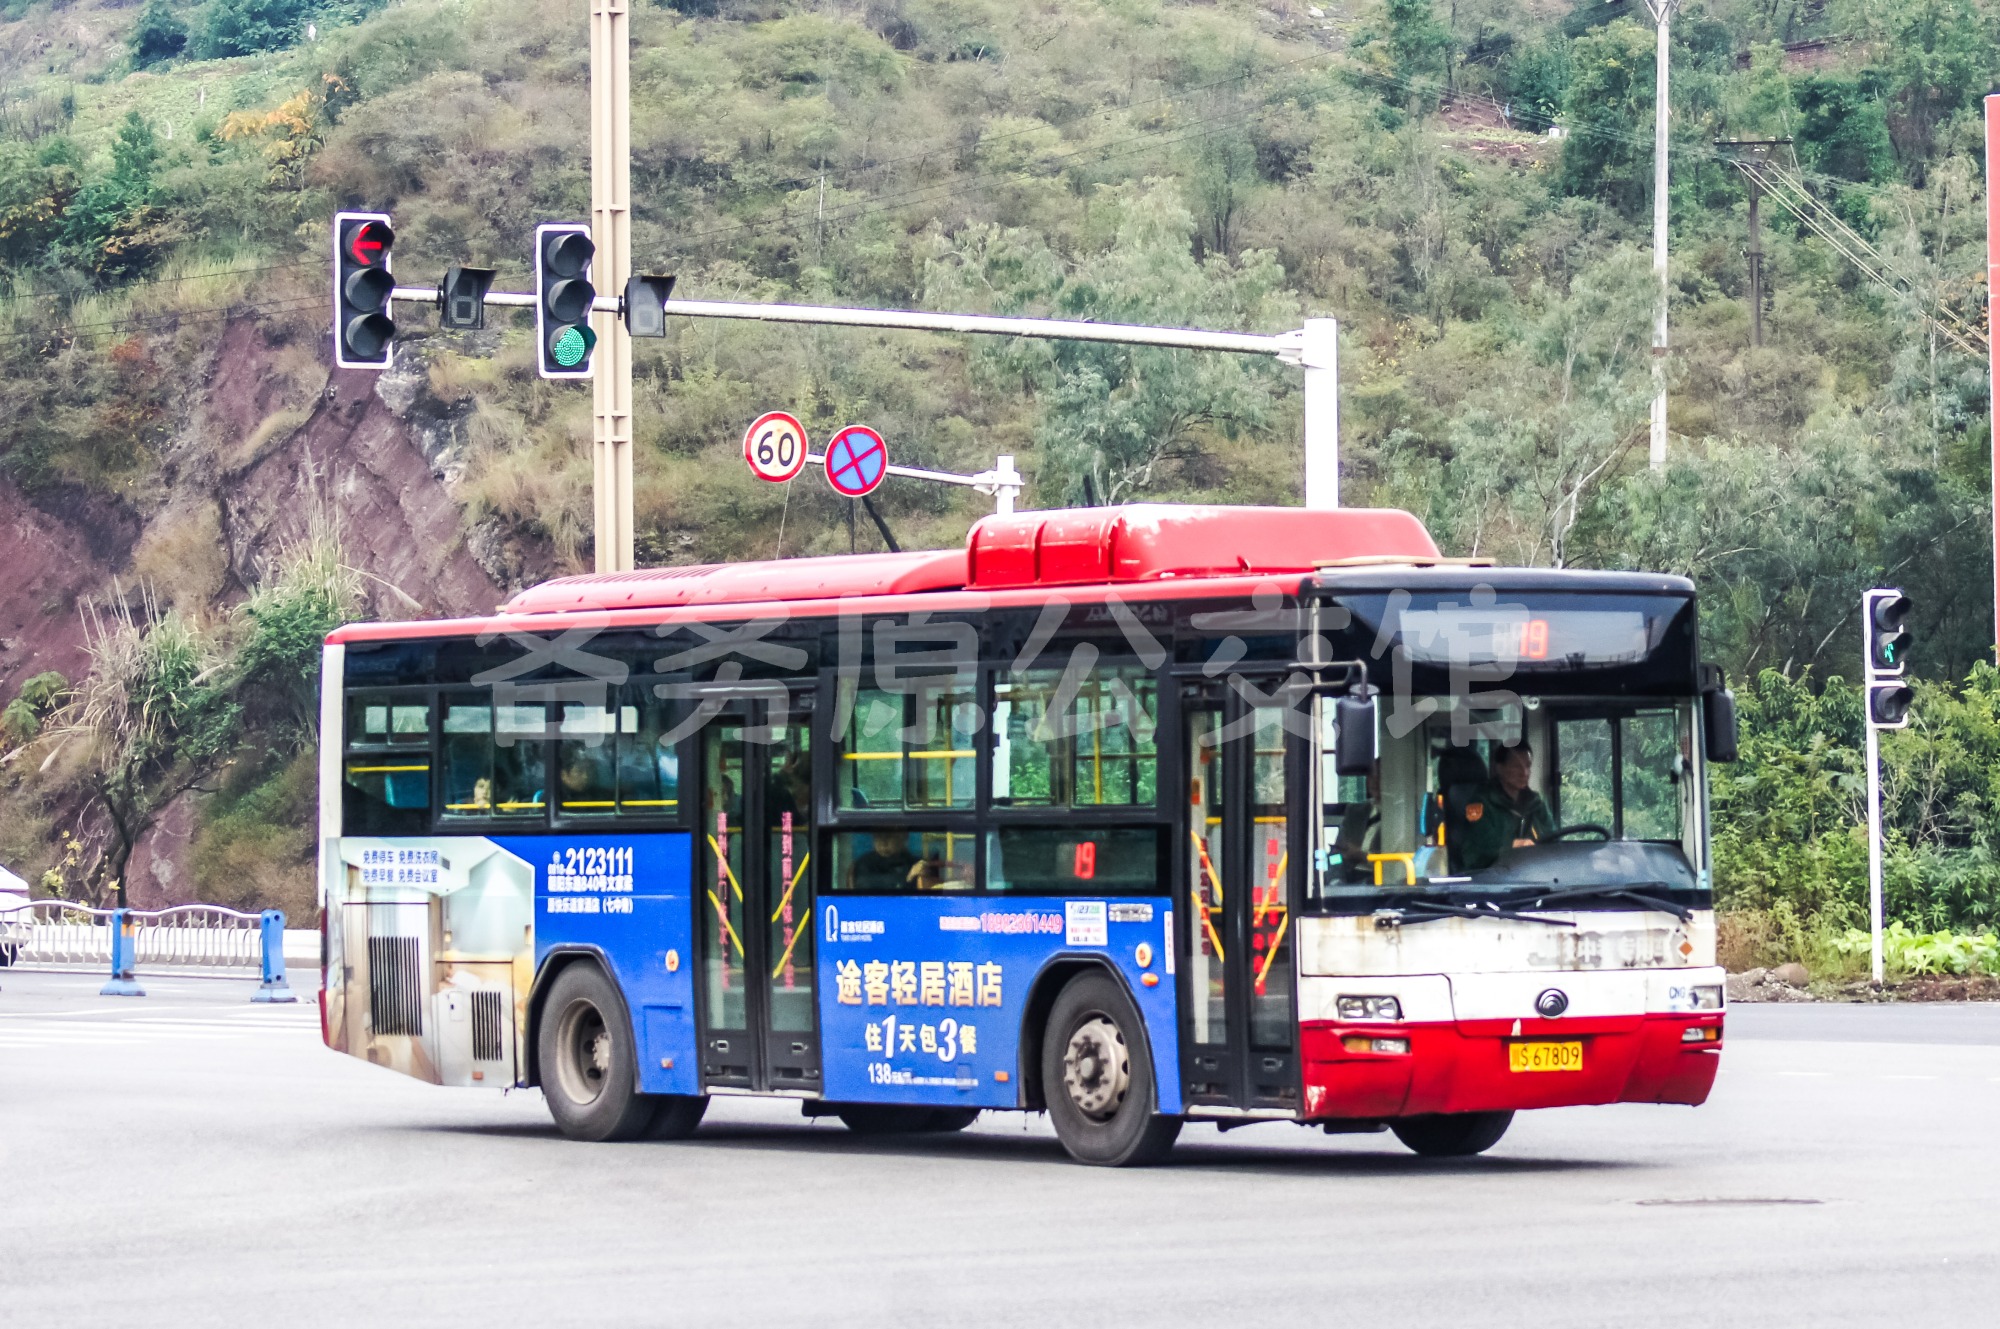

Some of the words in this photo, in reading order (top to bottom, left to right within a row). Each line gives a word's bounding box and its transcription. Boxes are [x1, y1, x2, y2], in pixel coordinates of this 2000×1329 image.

[757, 430, 795, 467] 60
[1519, 619, 1550, 660] 19
[363, 850, 394, 864] 免费停车
[1074, 841, 1097, 880] 19
[835, 958, 1003, 1007] 途客轻居酒店
[1668, 986, 1686, 999] CNG
[864, 1014, 978, 1062] 住1天包3餐
